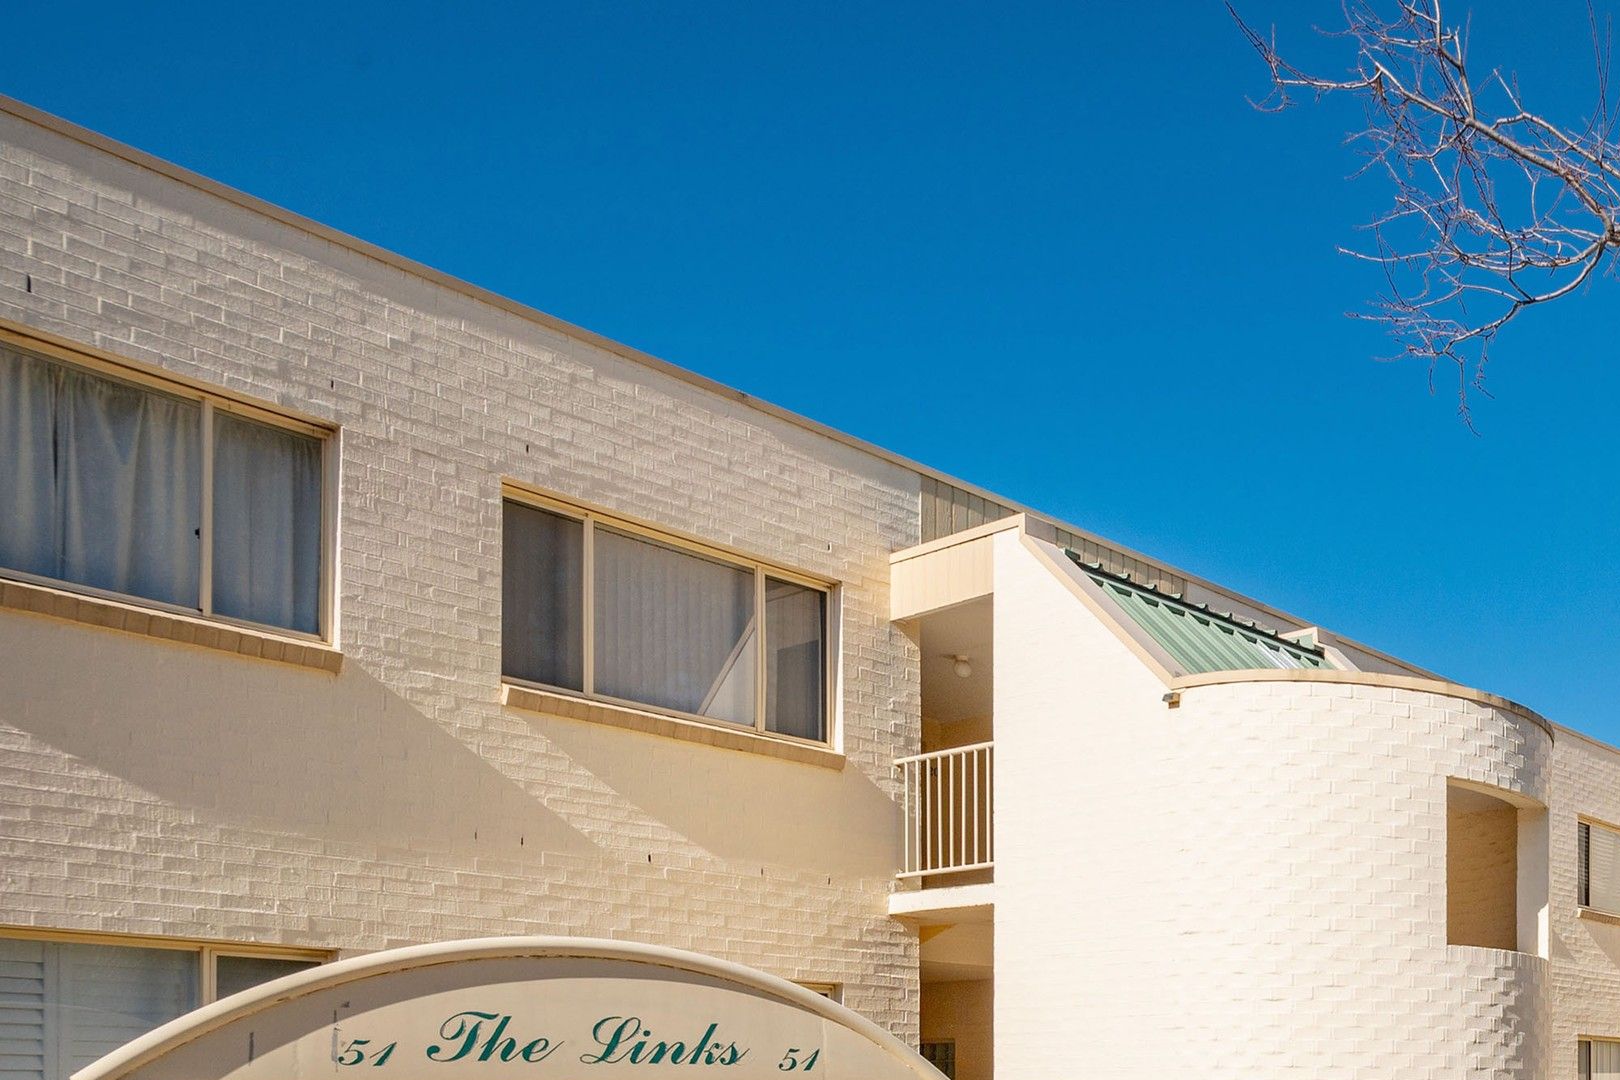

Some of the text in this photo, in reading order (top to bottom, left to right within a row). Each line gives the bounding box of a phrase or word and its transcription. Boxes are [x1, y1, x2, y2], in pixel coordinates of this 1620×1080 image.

[338, 1011, 820, 1071] 51 The Links 51
